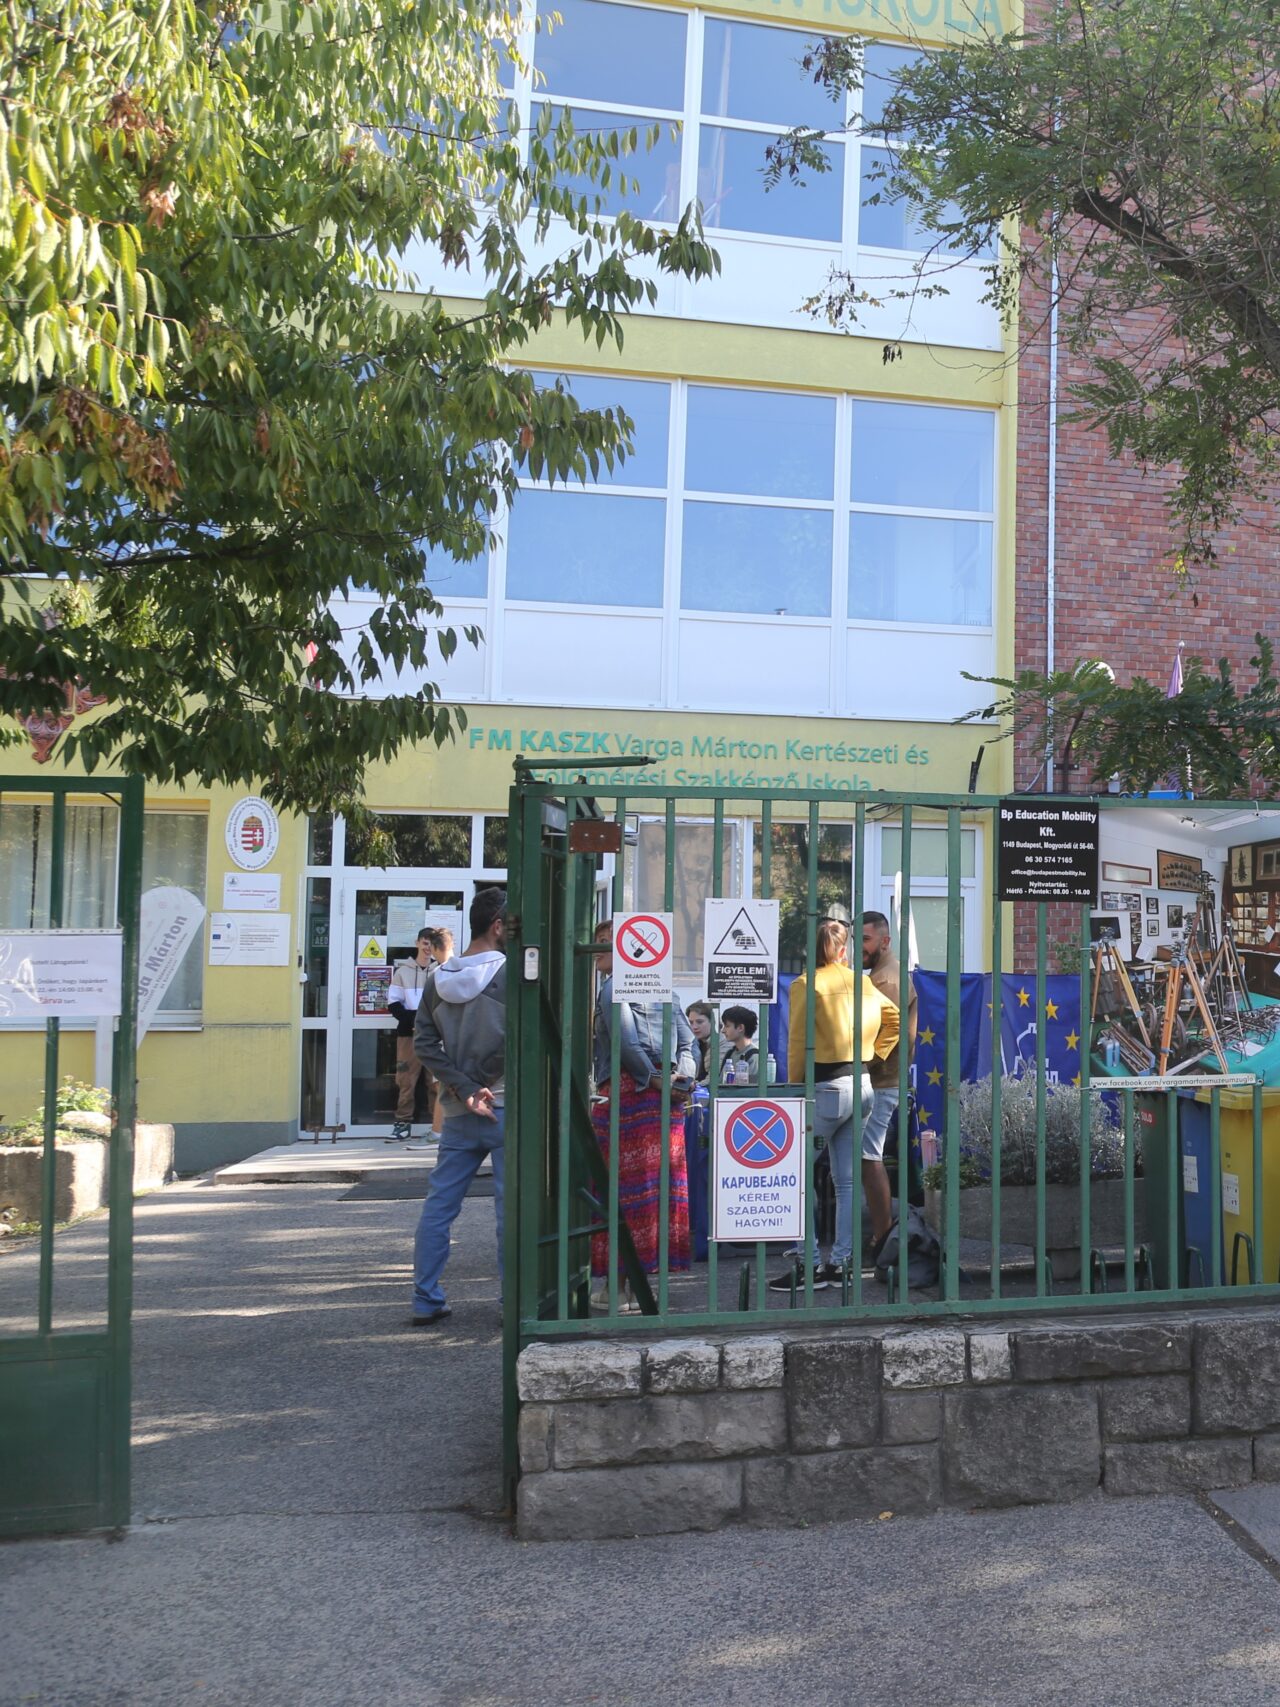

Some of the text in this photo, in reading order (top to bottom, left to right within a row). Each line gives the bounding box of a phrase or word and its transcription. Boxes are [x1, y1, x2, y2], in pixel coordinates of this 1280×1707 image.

[520, 729, 610, 754] KASZK
[614, 733, 684, 761] Varga
[690, 735, 777, 760] Márton
[786, 739, 898, 764] Kertészeti
[905, 744, 929, 765] és
[1001, 809, 1097, 823] Bp Education Mobility
[1039, 827, 1056, 837] Kft.
[145, 915, 188, 973] Márton
[715, 966, 766, 975] FIGYELEM!
[721, 1172, 797, 1189] KAPUBEJÁRÓ
[738, 1191, 780, 1203] KÉREM
[726, 1205, 792, 1216] SZABADON
[735, 1218, 783, 1228] HAGYNI!
